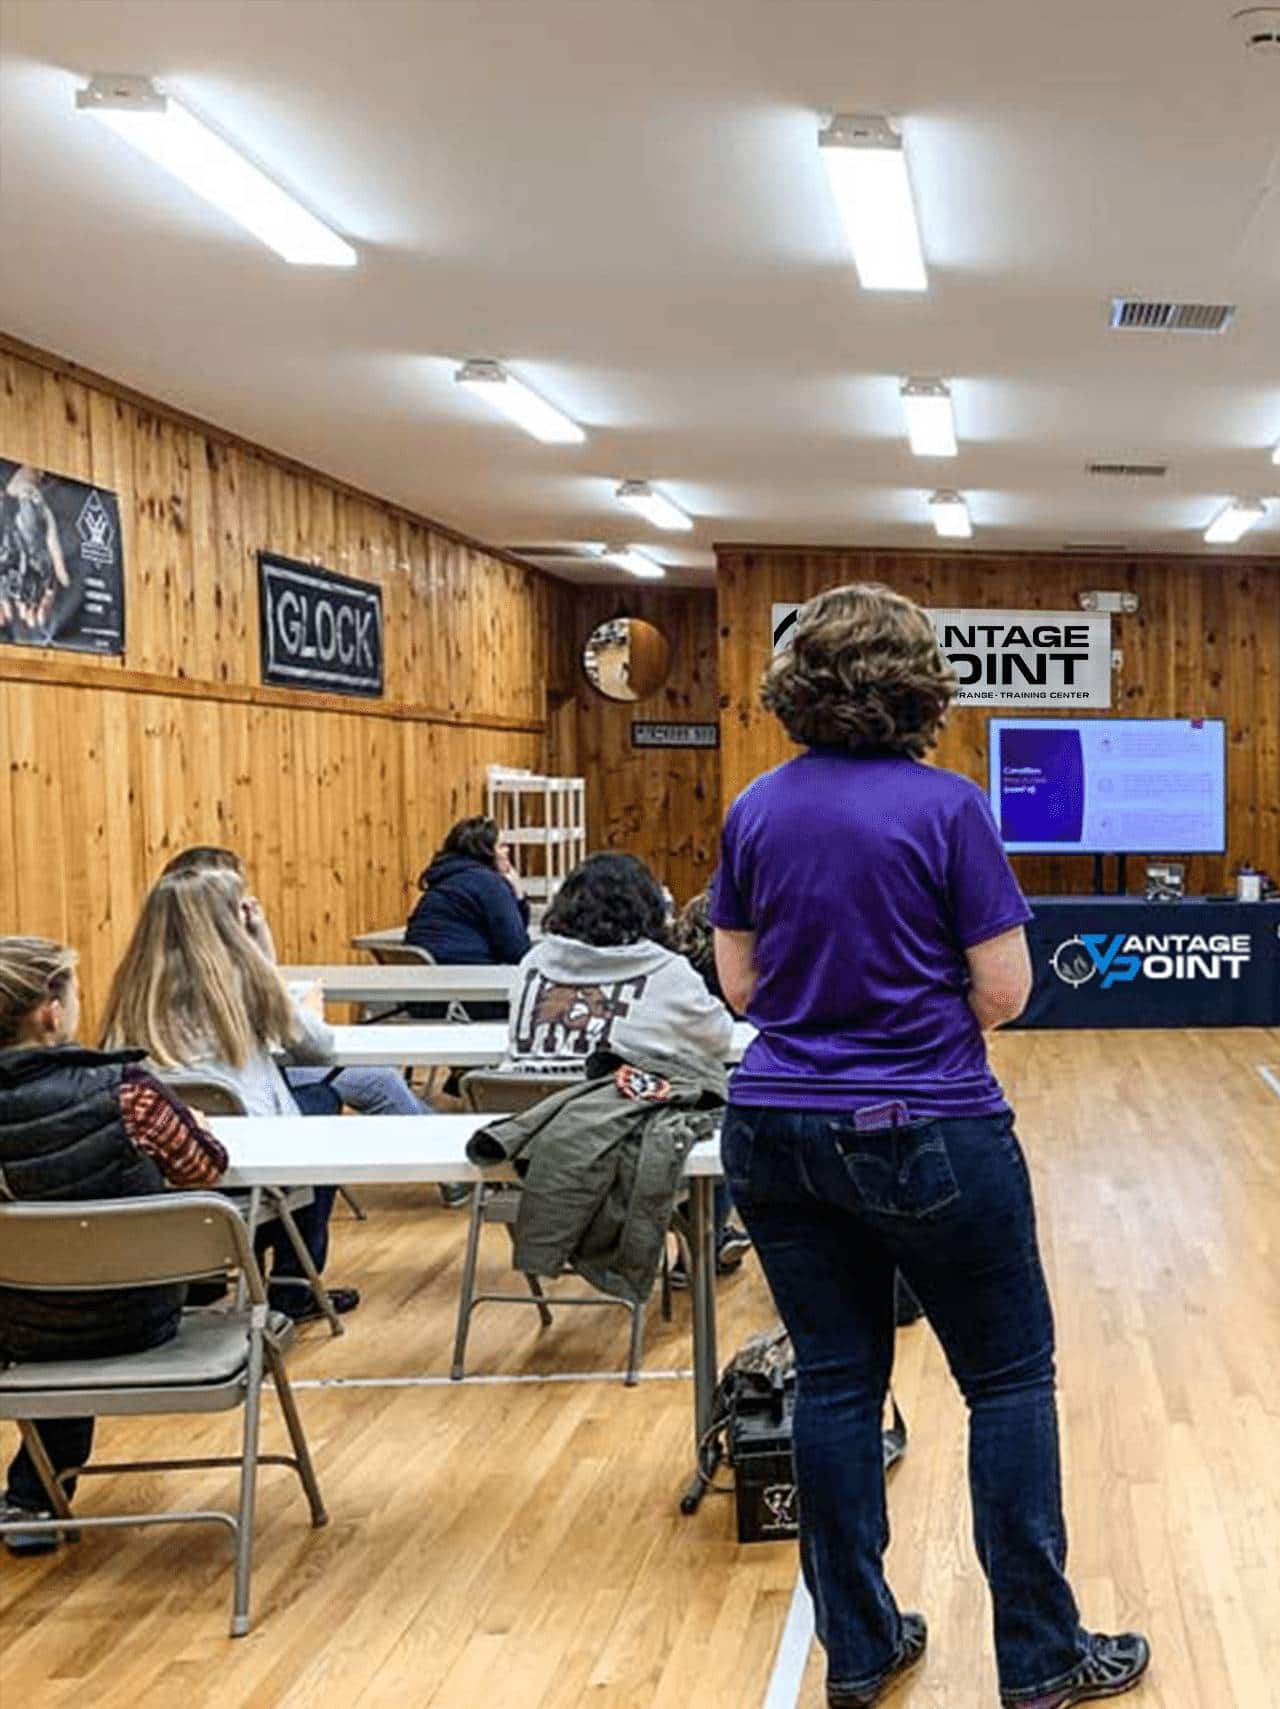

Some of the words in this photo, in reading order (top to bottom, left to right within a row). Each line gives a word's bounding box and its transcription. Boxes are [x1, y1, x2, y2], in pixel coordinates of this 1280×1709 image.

[276, 589, 374, 669] GLOCK
[940, 625, 1090, 648] NTAGE
[1000, 691, 1047, 699] TRAINING
[1049, 691, 1090, 699] CENTER
[1080, 933, 1251, 977] VANTAGE
[1100, 954, 1250, 989] POINT
